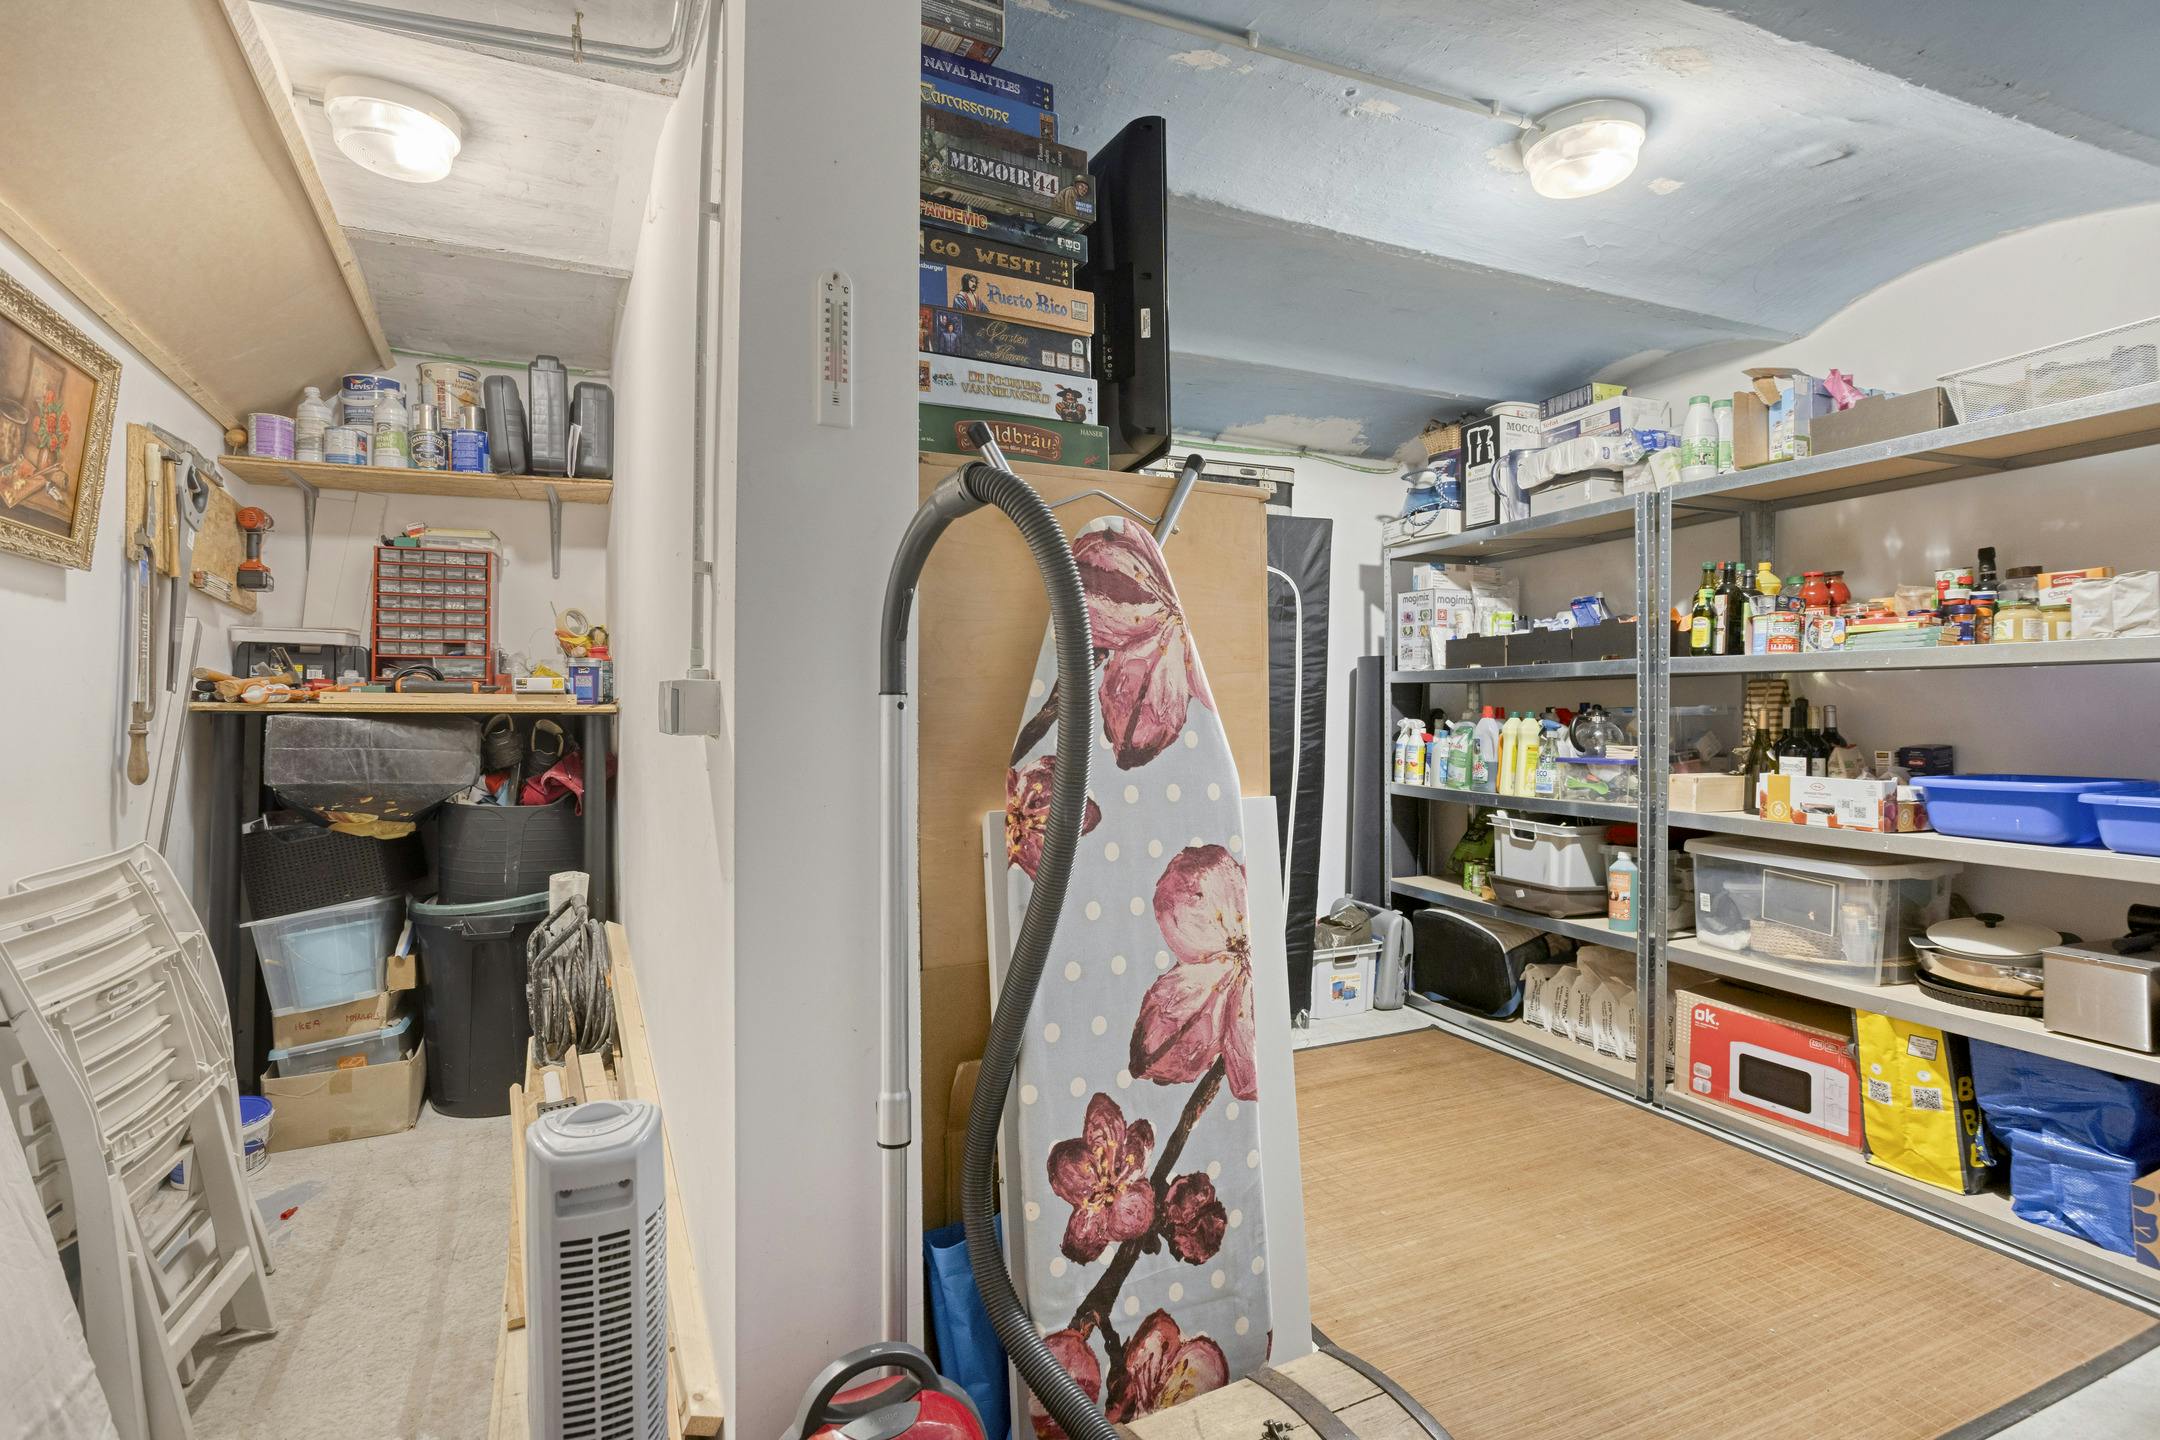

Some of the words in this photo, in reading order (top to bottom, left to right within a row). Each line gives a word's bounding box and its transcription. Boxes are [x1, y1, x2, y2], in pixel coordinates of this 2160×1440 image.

[923, 55, 968, 78] NAVAL
[969, 69, 1020, 95] BATTLES
[920, 81, 1010, 124] Carcassonne
[950, 150, 1031, 188] MEMOIR
[920, 199, 988, 230] PANDEMIC
[919, 262, 944, 272] sburger
[930, 238, 961, 257] GO
[975, 248, 1041, 276] WEST!
[987, 283, 1033, 311] Puerto
[1036, 292, 1068, 317] Rico
[968, 370, 985, 382] DE
[994, 425, 1052, 450] ldbräu
[1080, 429, 1103, 438] HANSER
[1403, 592, 1429, 605] magimix
[1437, 594, 1473, 607] magimix
[295, 1020, 320, 1031] IKEA
